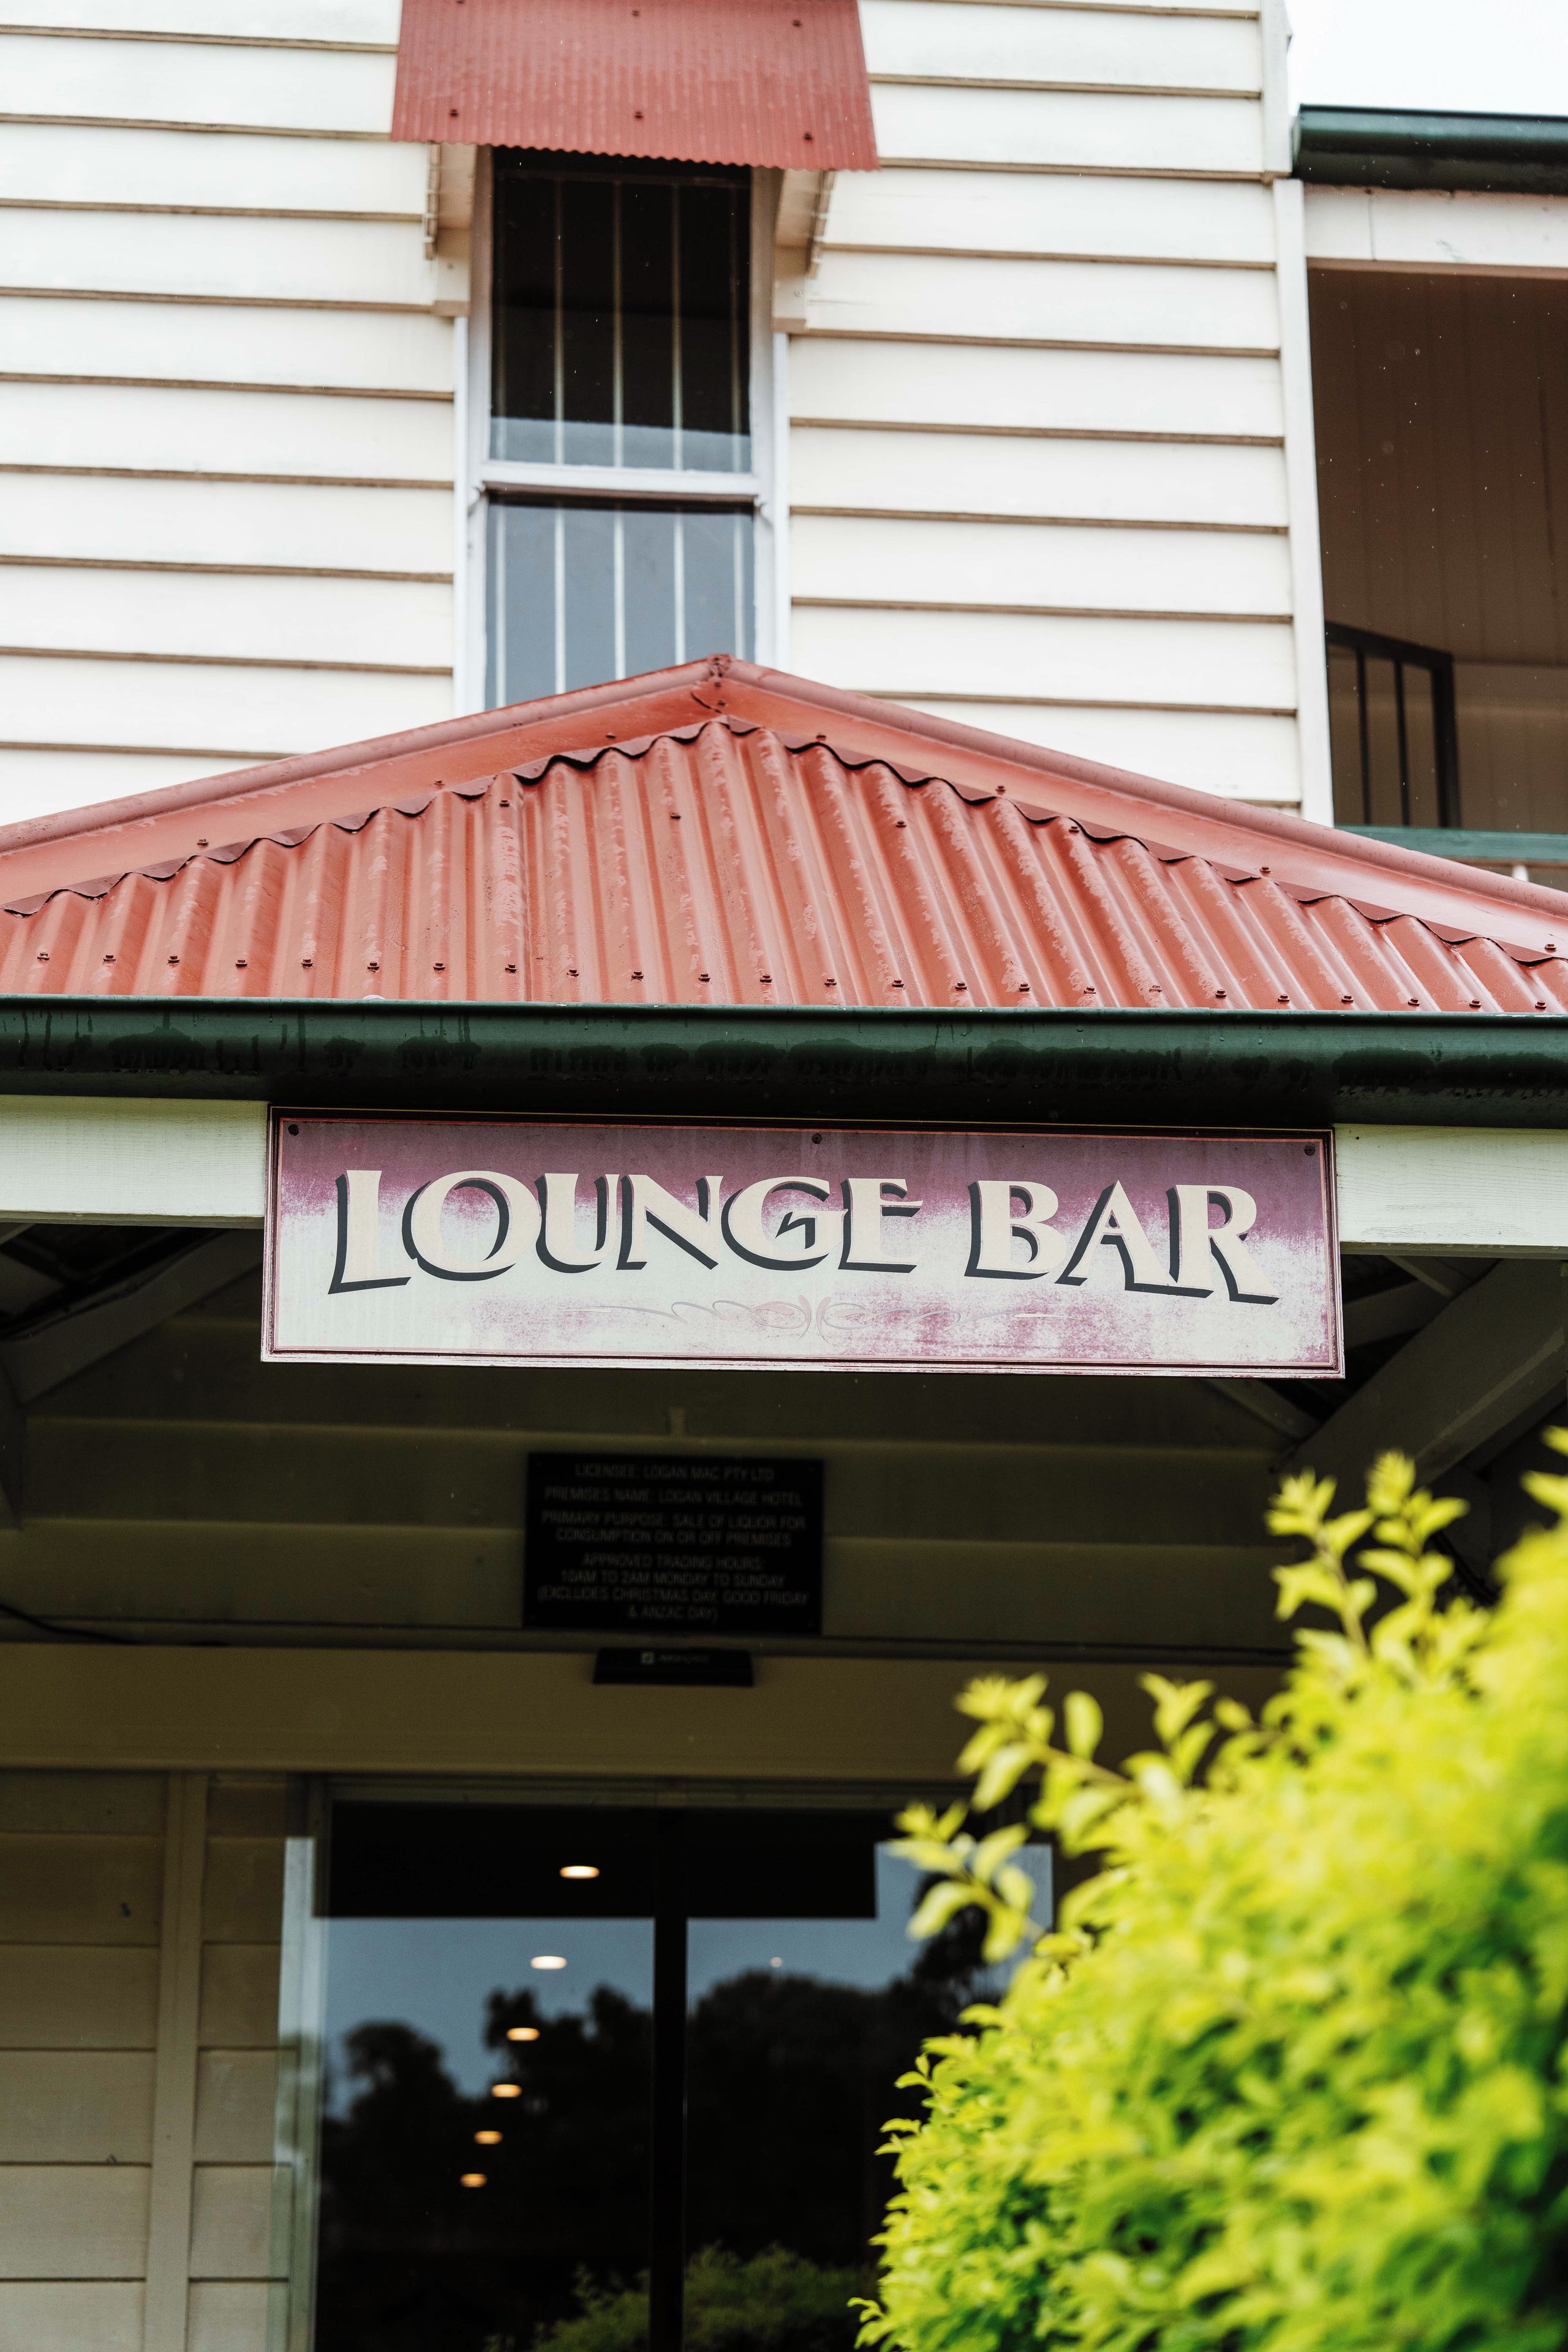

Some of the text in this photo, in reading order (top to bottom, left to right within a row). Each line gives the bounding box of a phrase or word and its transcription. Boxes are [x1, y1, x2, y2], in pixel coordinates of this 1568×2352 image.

[328, 1169, 1279, 1305] LOUNGE BAR
[643, 1464, 687, 1480] LOGAN
[690, 1465, 721, 1480] MAC
[723, 1466, 748, 1481] PTY
[751, 1466, 775, 1481] LTD
[545, 1485, 611, 1502] PREMISES
[658, 1489, 703, 1504] LOGAN
[705, 1490, 758, 1506] VILLAGE
[761, 1491, 803, 1507] HOTEL
[541, 1510, 600, 1525] PRIMARY
[671, 1513, 705, 1528] SALE
[708, 1514, 725, 1529] OF
[728, 1514, 777, 1529] LIQUOR
[780, 1516, 806, 1530] FOR
[556, 1527, 792, 1548] CONSUMPTION ON OR OFF PREMISES
[581, 1551, 654, 1568] APPROVED
[657, 1553, 713, 1569] TRADING
[562, 1569, 786, 1588] 10AM TO 2AM MONDAY TO SUNDAY
[537, 1585, 609, 1602] (EXCLUDES
[612, 1586, 689, 1603] CHRISTMAS
[722, 1589, 761, 1605] GOOD
[763, 1591, 809, 1606] FRIDAY
[627, 1604, 719, 1625] & ANZAC DAY)
